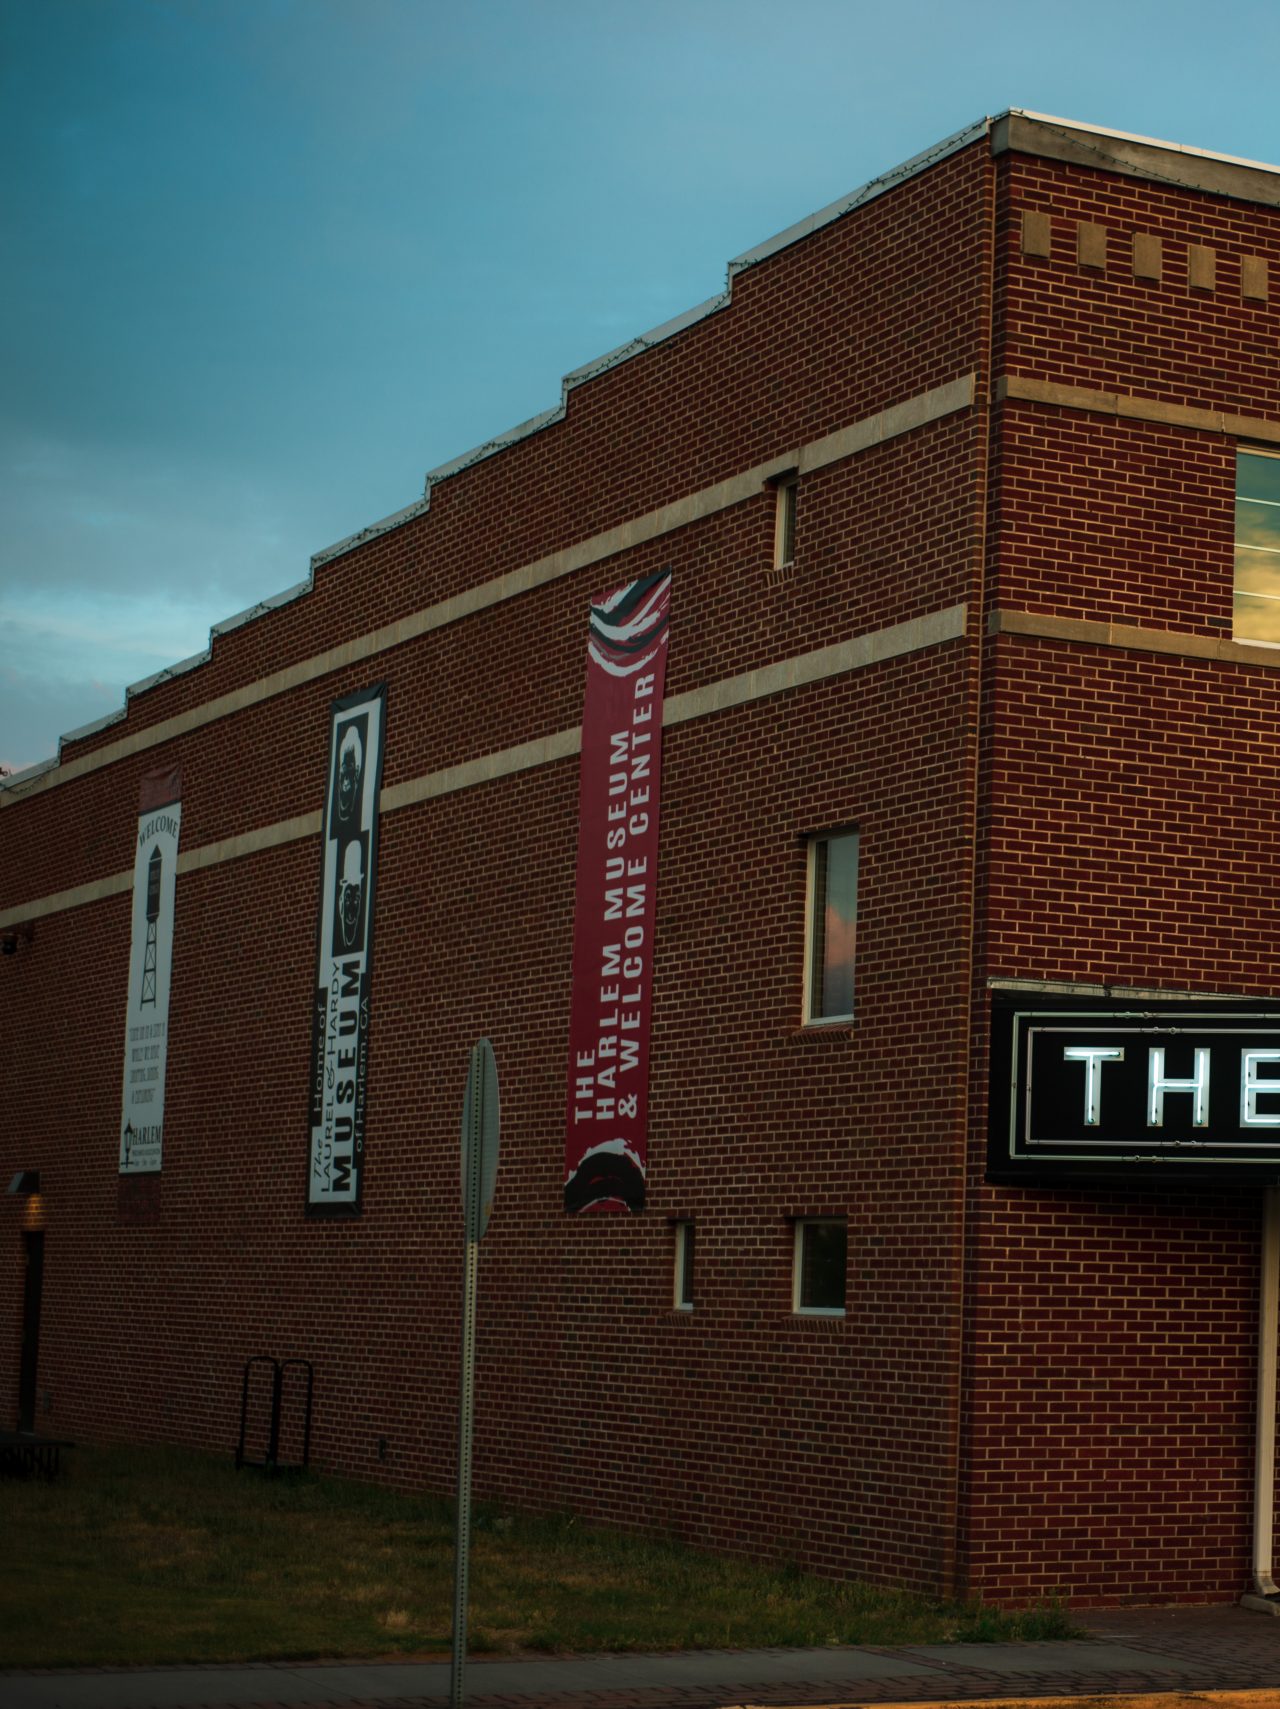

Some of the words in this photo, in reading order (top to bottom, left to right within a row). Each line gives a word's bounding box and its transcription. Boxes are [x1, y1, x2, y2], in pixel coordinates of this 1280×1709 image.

[629, 673, 655, 836] CENTER
[139, 815, 178, 848] WELCOME
[604, 730, 629, 920] MUSEUM
[619, 856, 647, 1073] WELCOME
[317, 1002, 326, 1029] of
[327, 962, 340, 1055] HARDY
[360, 996, 369, 1030] GA
[596, 943, 621, 1120] HARLEM
[313, 1035, 324, 1112] Home
[326, 1062, 336, 1090] &
[332, 960, 360, 1192] MUSEUM
[356, 1034, 368, 1123] Harlem,
[574, 1049, 595, 1125] THE
[618, 1093, 637, 1119] &
[132, 1125, 162, 1146] HARLEM
[313, 1138, 323, 1178] The
[321, 1095, 334, 1192] LAUREL
[355, 1130, 363, 1152] of
